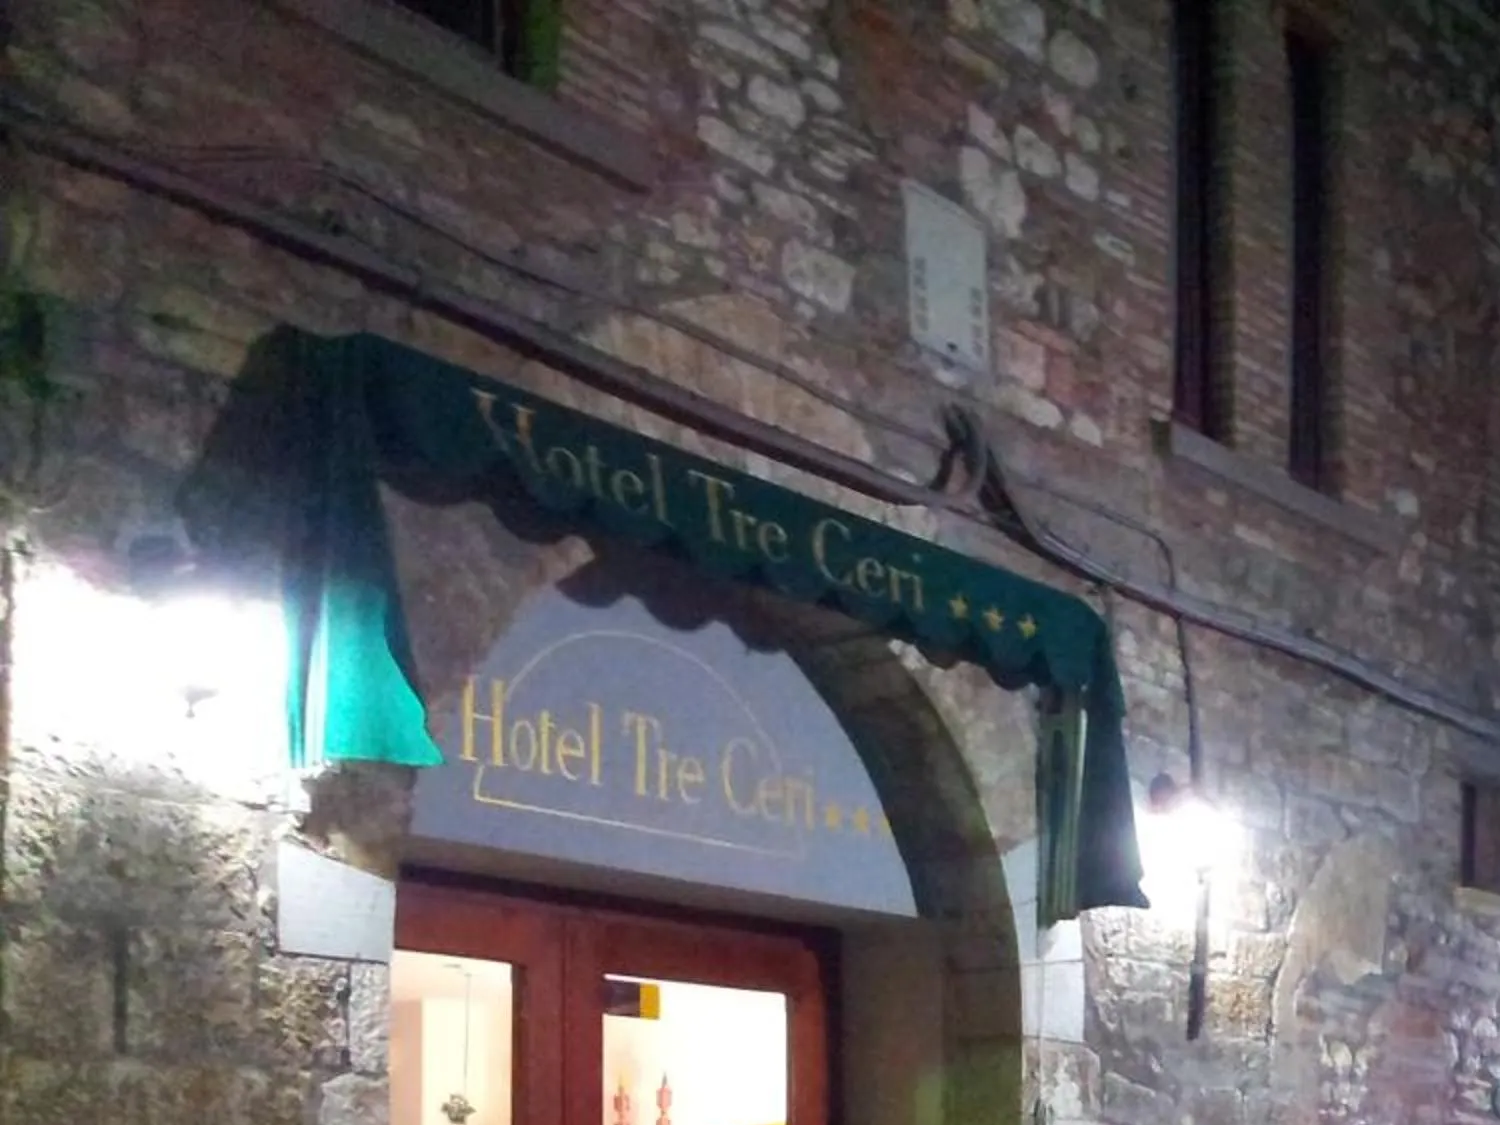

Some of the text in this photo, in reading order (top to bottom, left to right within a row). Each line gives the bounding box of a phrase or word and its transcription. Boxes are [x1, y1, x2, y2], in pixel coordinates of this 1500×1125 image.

[688, 469, 790, 562] Tre
[812, 518, 926, 611] Ceri
[460, 676, 816, 830] Hotel Tre Ceri
